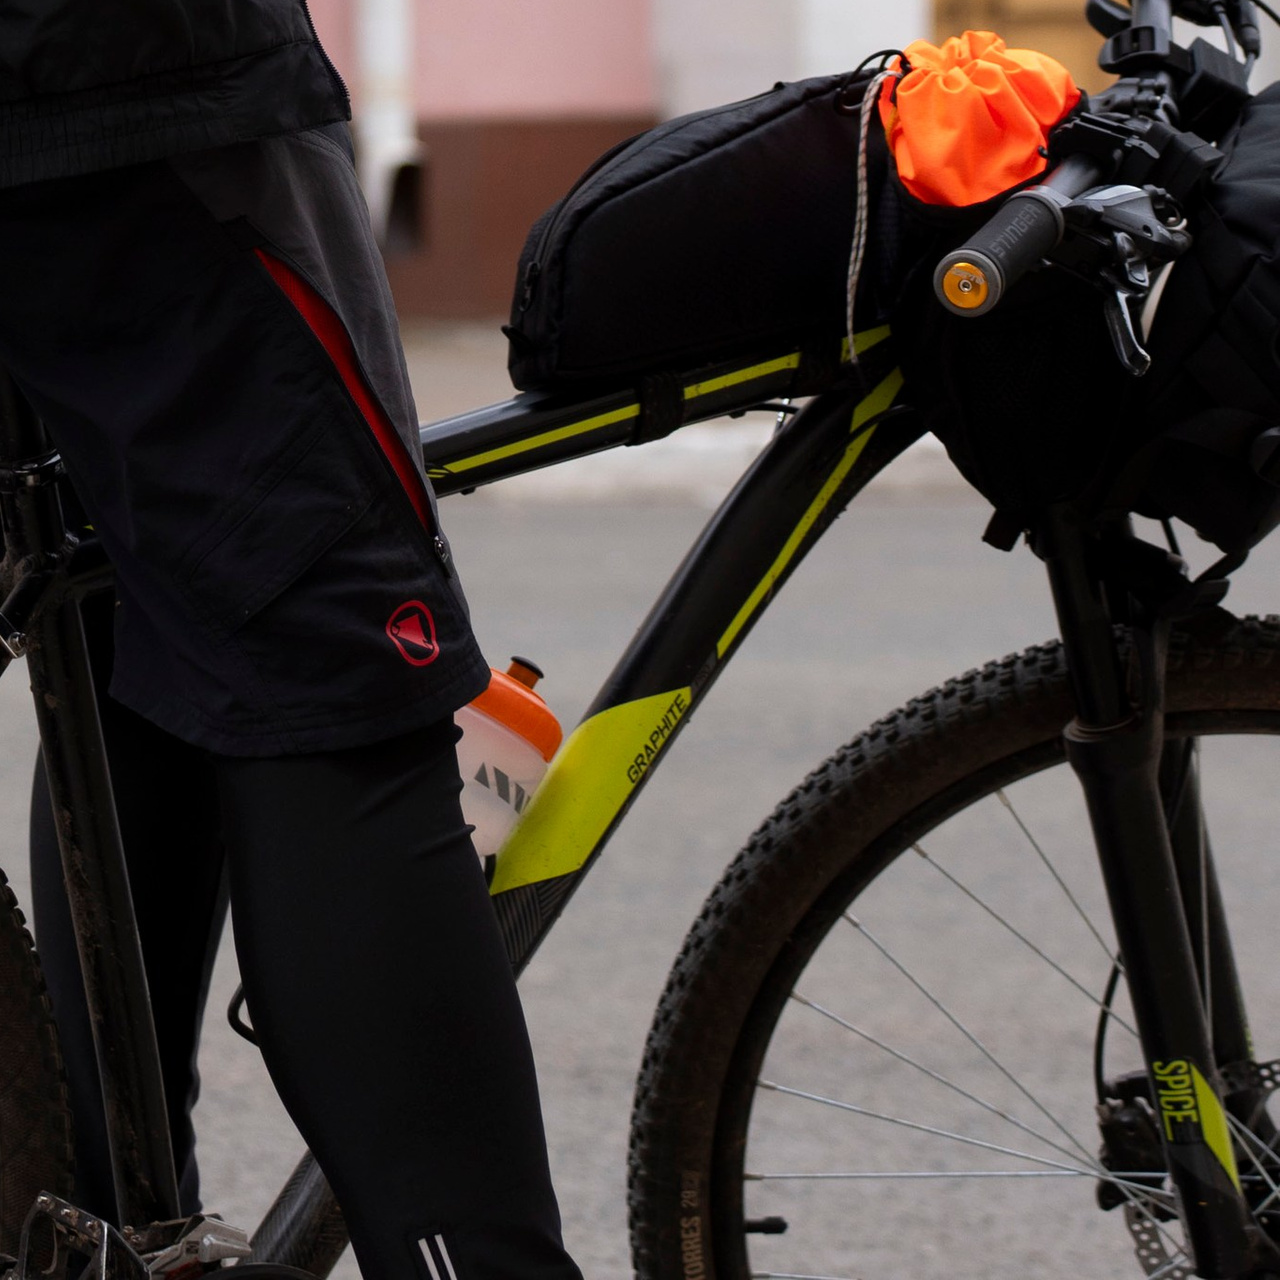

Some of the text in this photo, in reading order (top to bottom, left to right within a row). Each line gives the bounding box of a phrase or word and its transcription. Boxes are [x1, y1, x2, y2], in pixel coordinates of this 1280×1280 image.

[989, 203, 1042, 258] STINGER
[627, 694, 688, 785] GRAPHITE
[1153, 1059, 1198, 1142] SPICE
